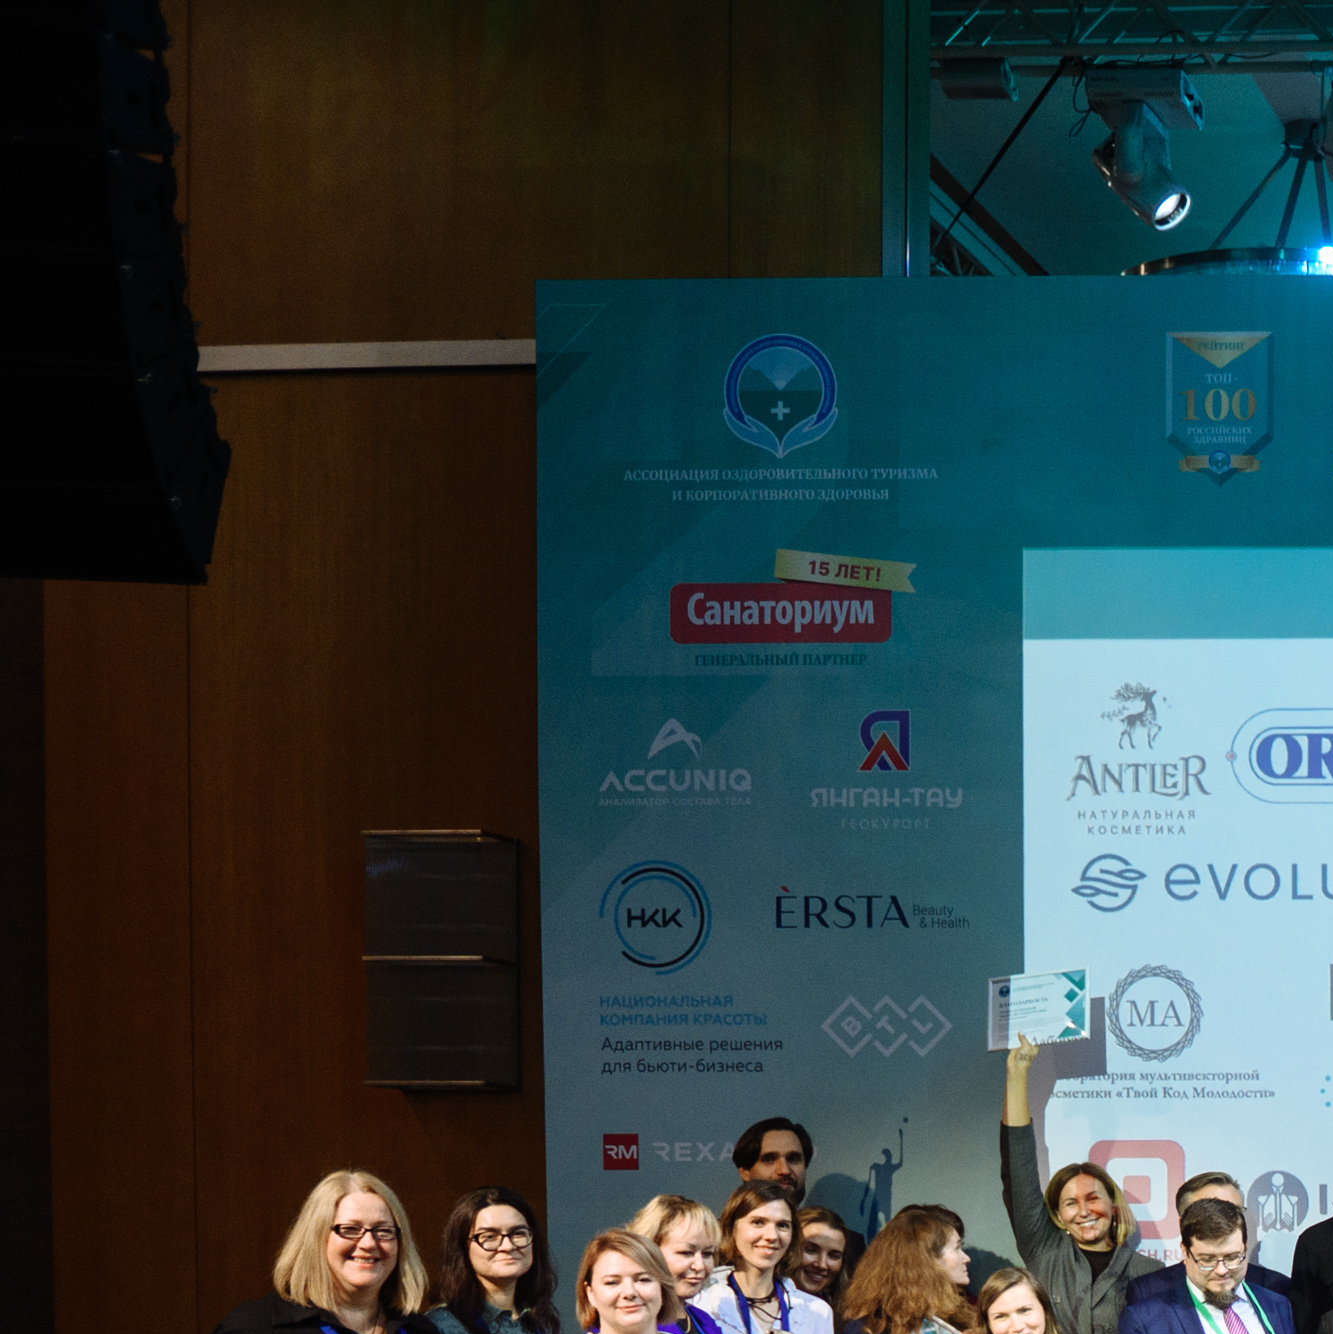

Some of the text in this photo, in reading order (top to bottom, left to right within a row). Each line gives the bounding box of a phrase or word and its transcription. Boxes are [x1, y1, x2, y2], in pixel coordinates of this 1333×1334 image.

[1180, 388, 1257, 421] 100
[623, 468, 938, 482] АССОЦИАЦИЯ ОЗДОРОВИТЕЛЬНОГО ТУРИЗМА
[672, 489, 889, 502] И КОРПОРАТИВНОГО ЗДОРОВЬЯ
[808, 560, 881, 582] 15 ЛЕТ!
[687, 592, 875, 634] Санаториум
[694, 652, 867, 667] ГЕНЕРАЛЬНЫЙ ПАРТНЕР
[599, 768, 753, 792] ACCUNIQ
[1065, 754, 1212, 801] ANTLER
[810, 787, 964, 809] ЯНГАН-ТАУ
[1077, 810, 1197, 820] НАТУРАЛЬНАЯ
[1086, 825, 1187, 835] КОСМЕТИКА
[775, 886, 910, 929] ÈRSTA
[912, 904, 954, 918] Beauty
[919, 916, 970, 929] & Health
[600, 996, 734, 1010] НАЦИОНАЛЬНАЯ
[600, 1013, 768, 1026] КОМПАНИЯ КРАСОТЫ
[601, 1038, 784, 1054] Адаптивные решения
[601, 1057, 764, 1075] для бьюти-бизнеса
[1139, 1069, 1260, 1085] мультивекторной
[1050, 1086, 1276, 1100] осметики «Твой Код Молодости»
